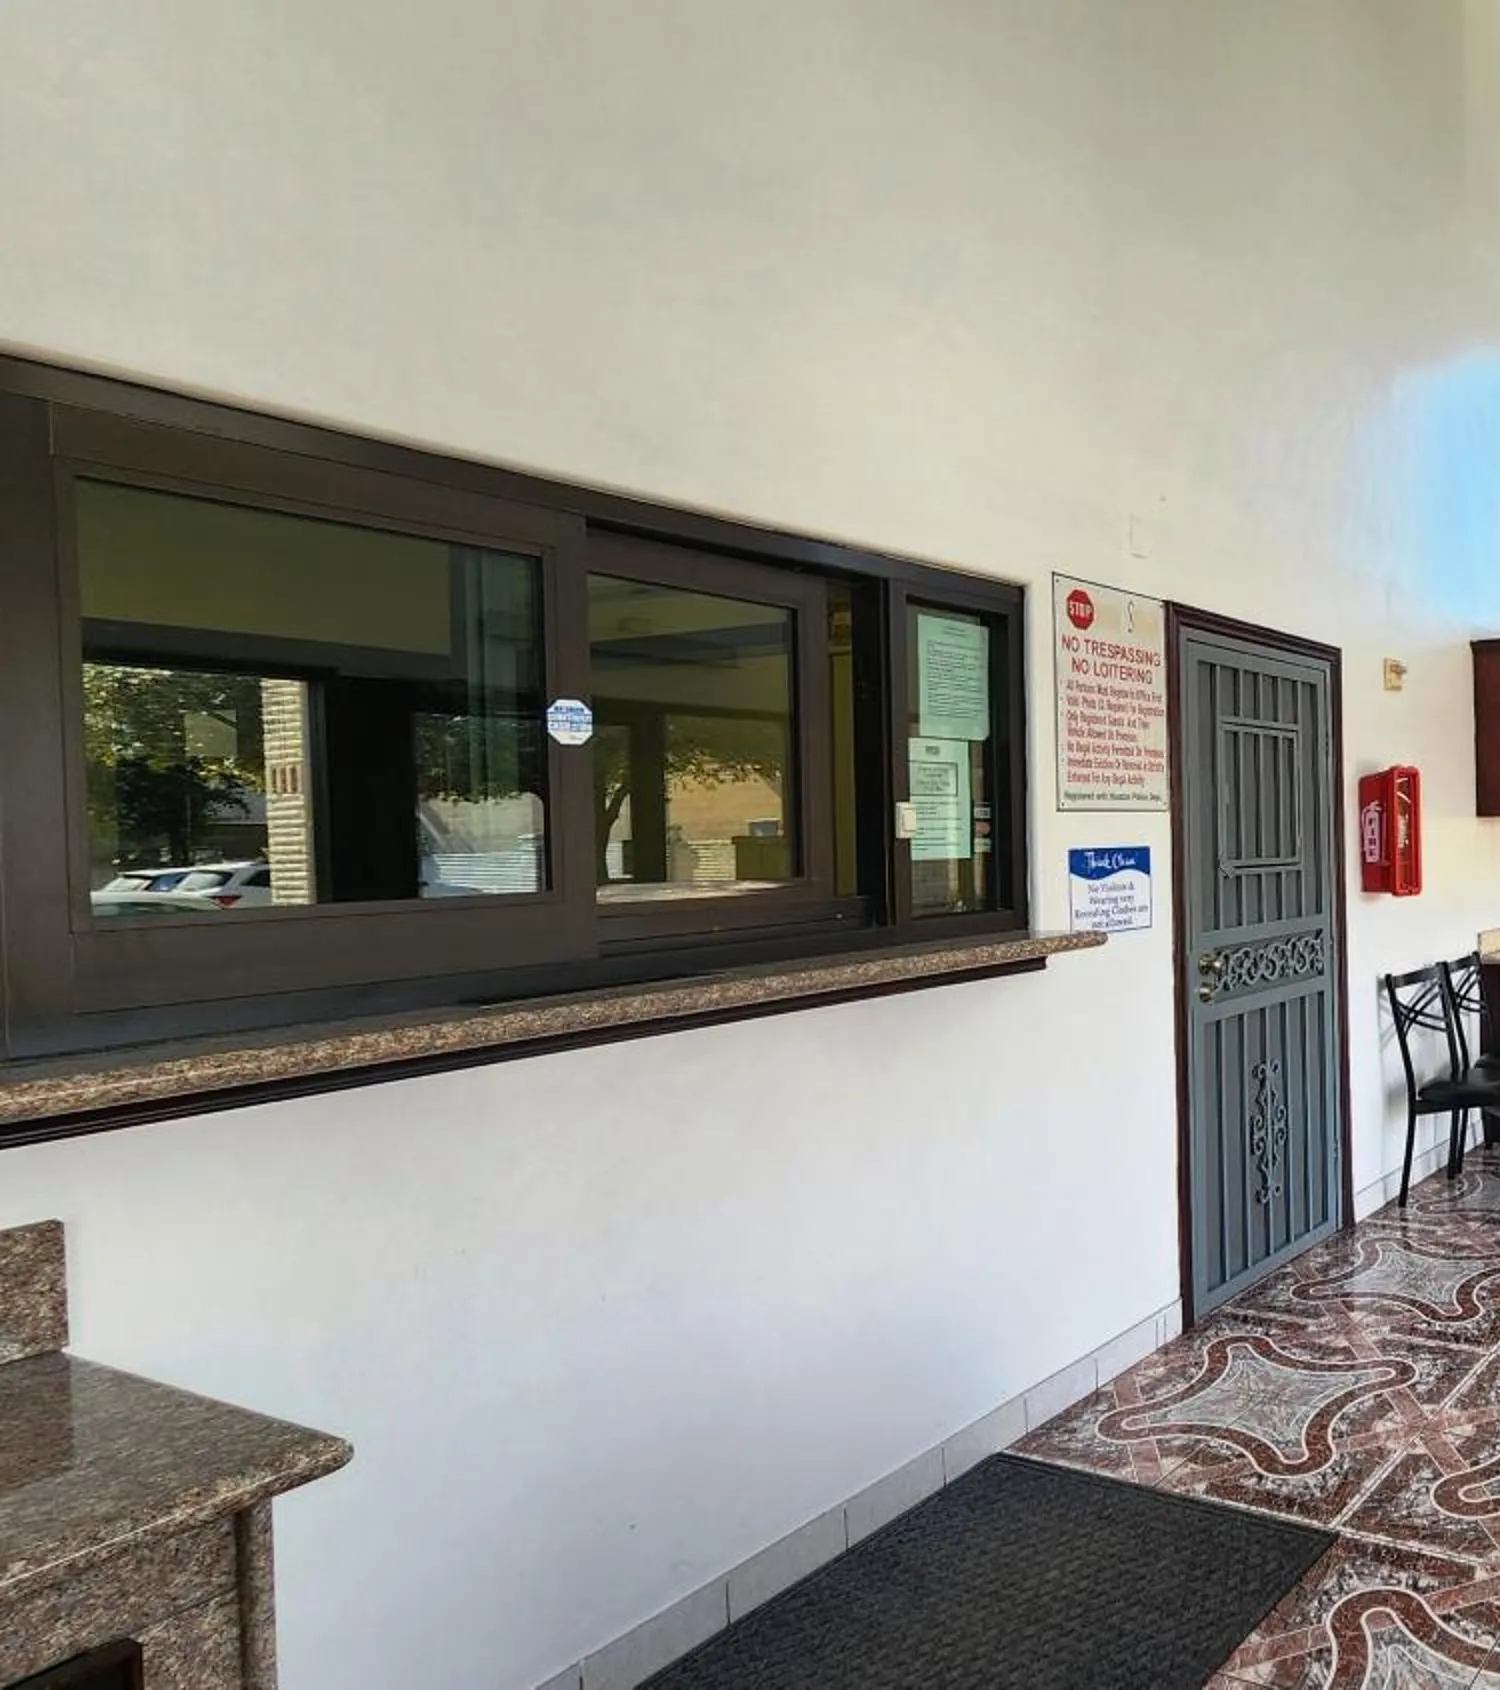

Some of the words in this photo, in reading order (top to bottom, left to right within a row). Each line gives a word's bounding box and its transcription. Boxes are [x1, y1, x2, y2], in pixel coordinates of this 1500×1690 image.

[1069, 601, 1093, 618] STOP
[1061, 634, 1080, 652] NO
[1084, 639, 1160, 666] TRESPASSING
[1072, 657, 1089, 674] NO
[1094, 661, 1152, 684] LOITERING
[1367, 817, 1376, 857] FIRE
